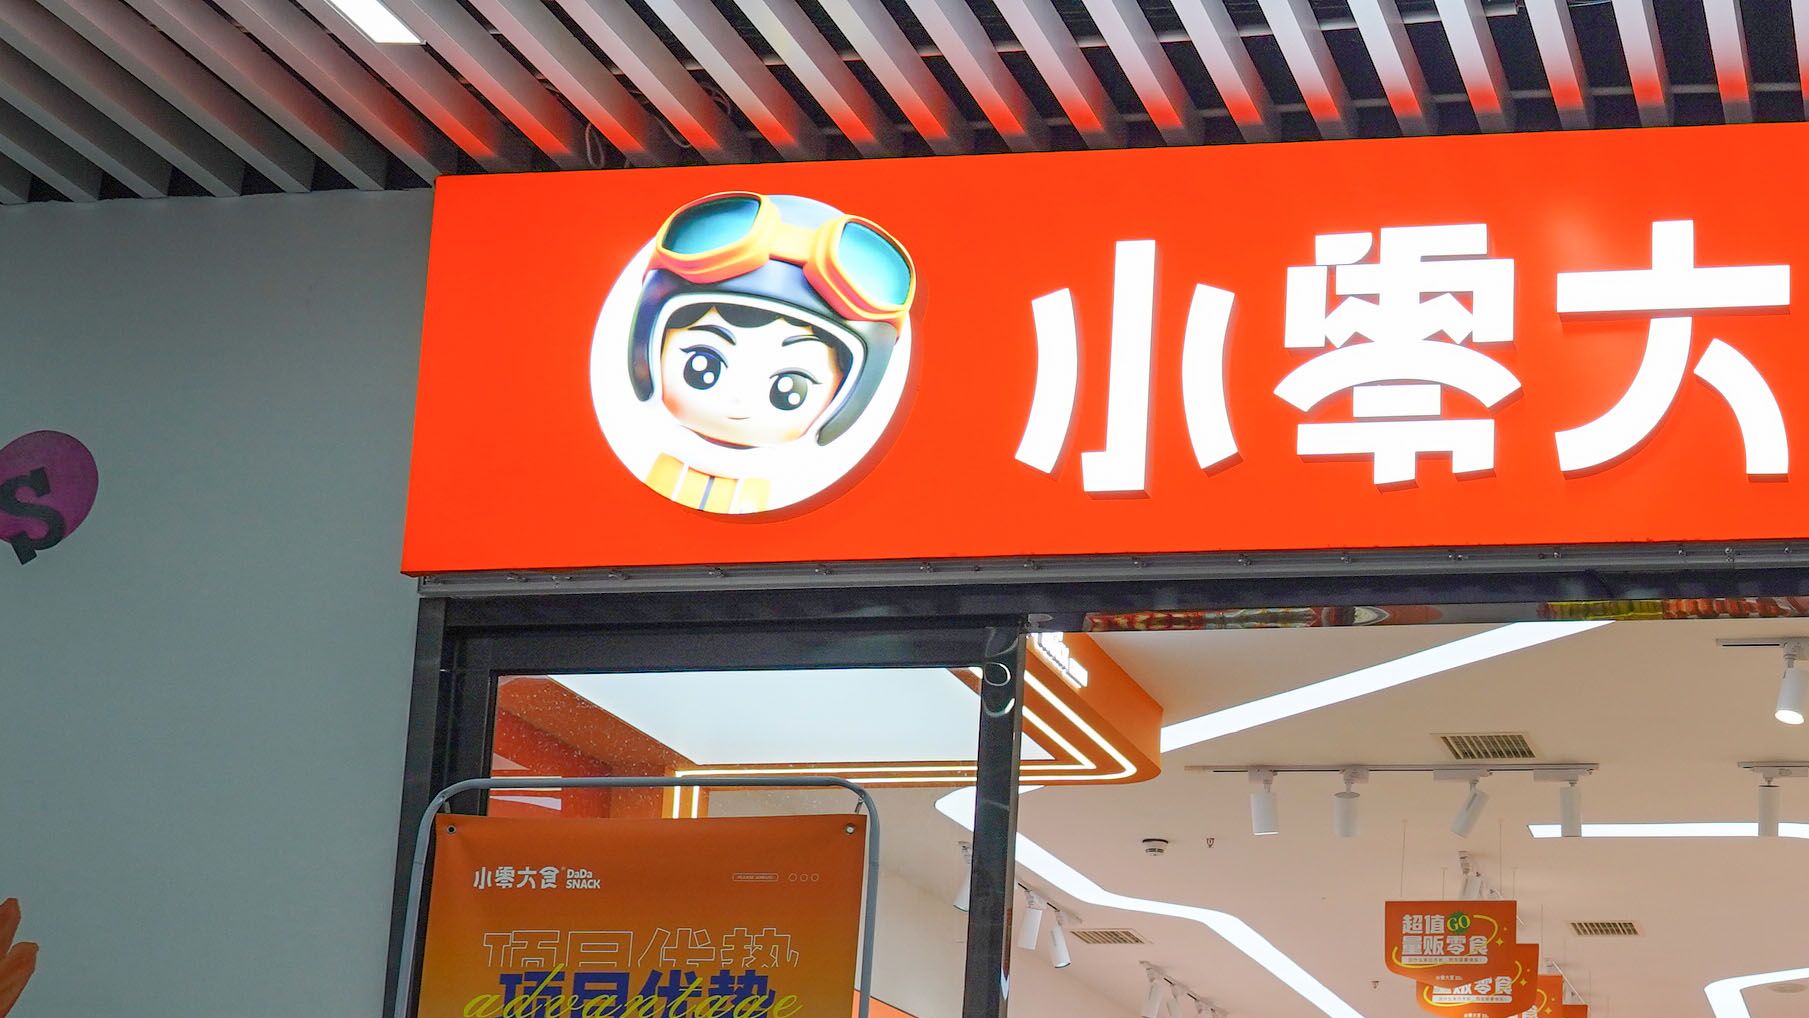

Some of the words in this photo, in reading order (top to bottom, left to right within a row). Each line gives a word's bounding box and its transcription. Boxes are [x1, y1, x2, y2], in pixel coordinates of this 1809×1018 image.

[567, 869, 592, 878] DaDa
[566, 879, 600, 889] SNACK
[1402, 914, 1445, 934] 超值
[1447, 915, 1471, 932] GO
[1402, 935, 1488, 955] 量贩零食
